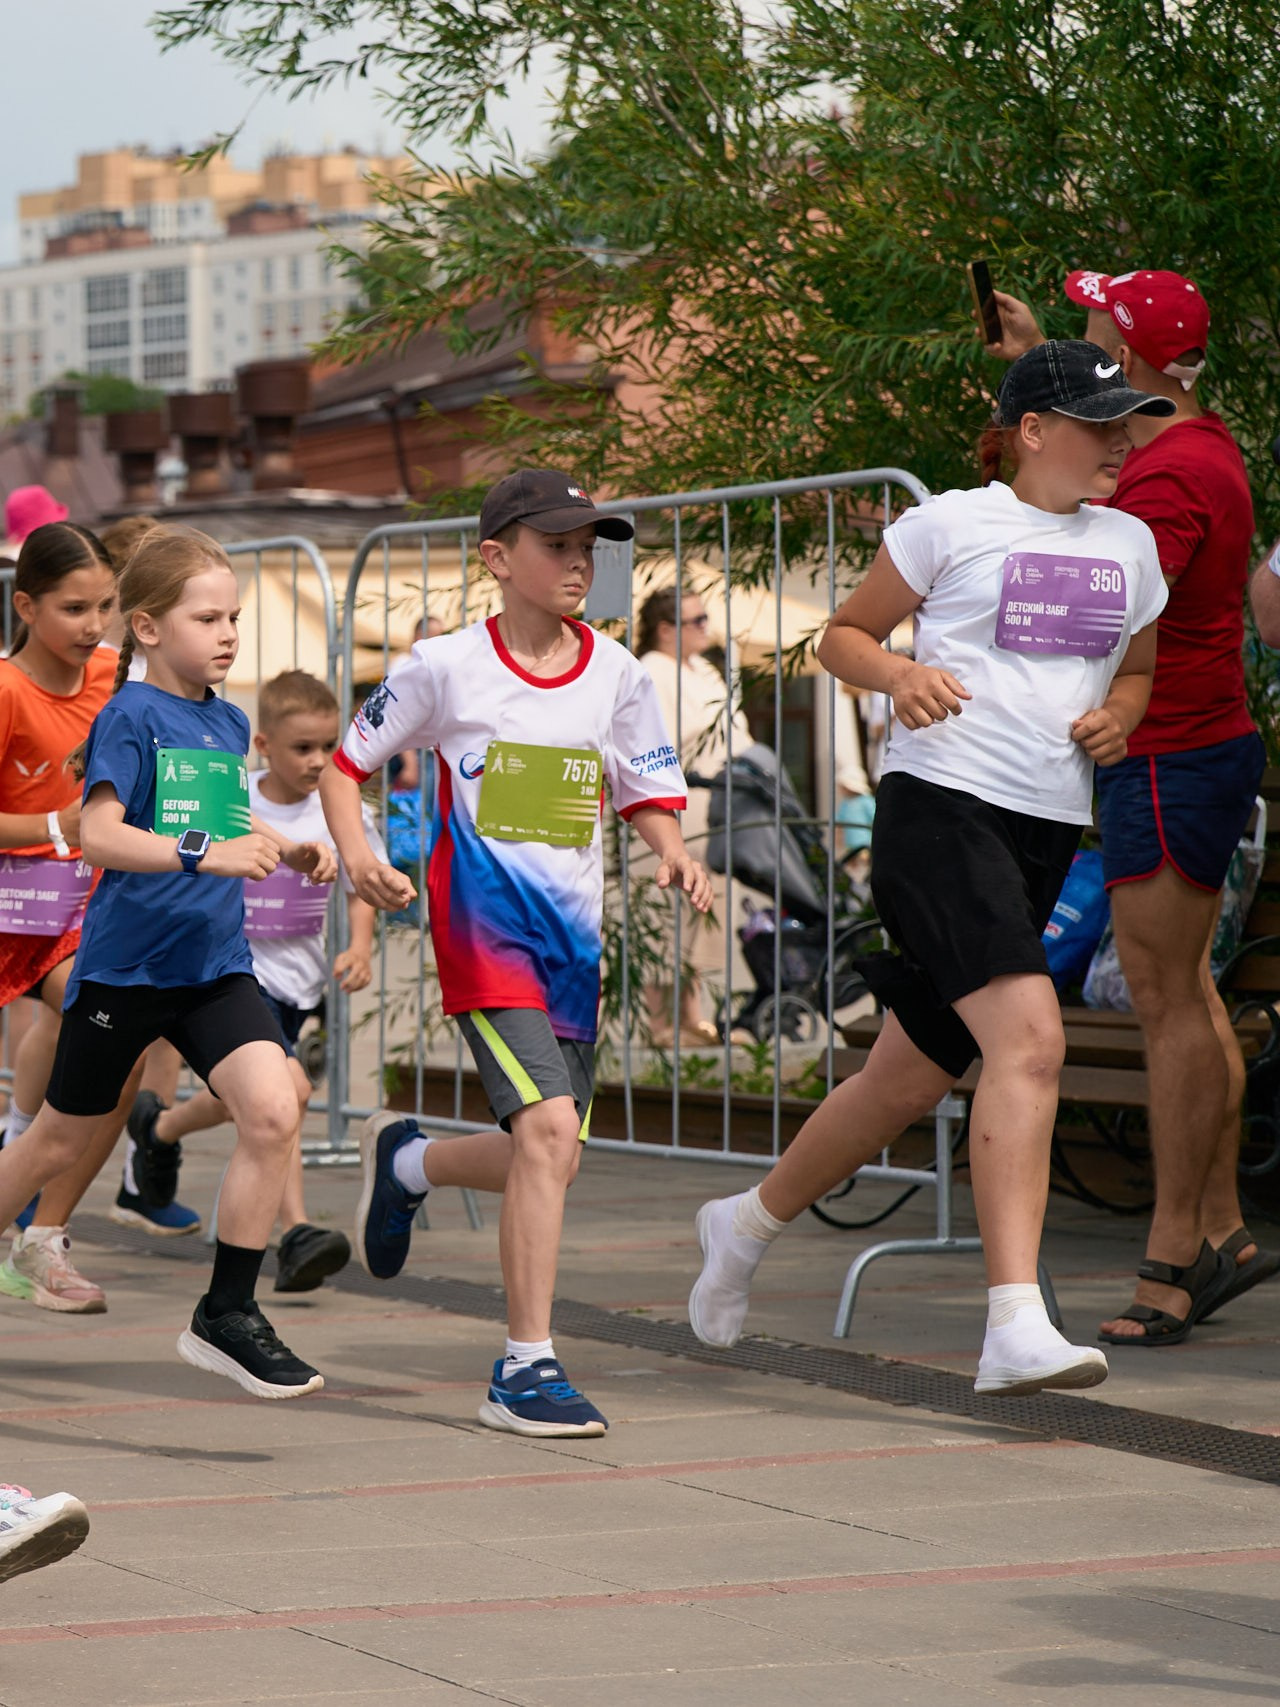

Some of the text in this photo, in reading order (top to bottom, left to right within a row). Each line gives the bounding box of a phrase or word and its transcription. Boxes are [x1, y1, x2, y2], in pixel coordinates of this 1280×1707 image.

[1090, 567, 1121, 593] 350
[1006, 601, 1069, 616] ДЕТСКИЙ ЗАБЕГ
[1004, 614, 1032, 627] 500 М
[562, 758, 598, 783] 7579
[580, 785, 586, 795] 3
[162, 799, 200, 811] БЕГОВЕЛ
[162, 812, 190, 824] 500 М
[36, 891, 60, 902] ЗАБЕГ
